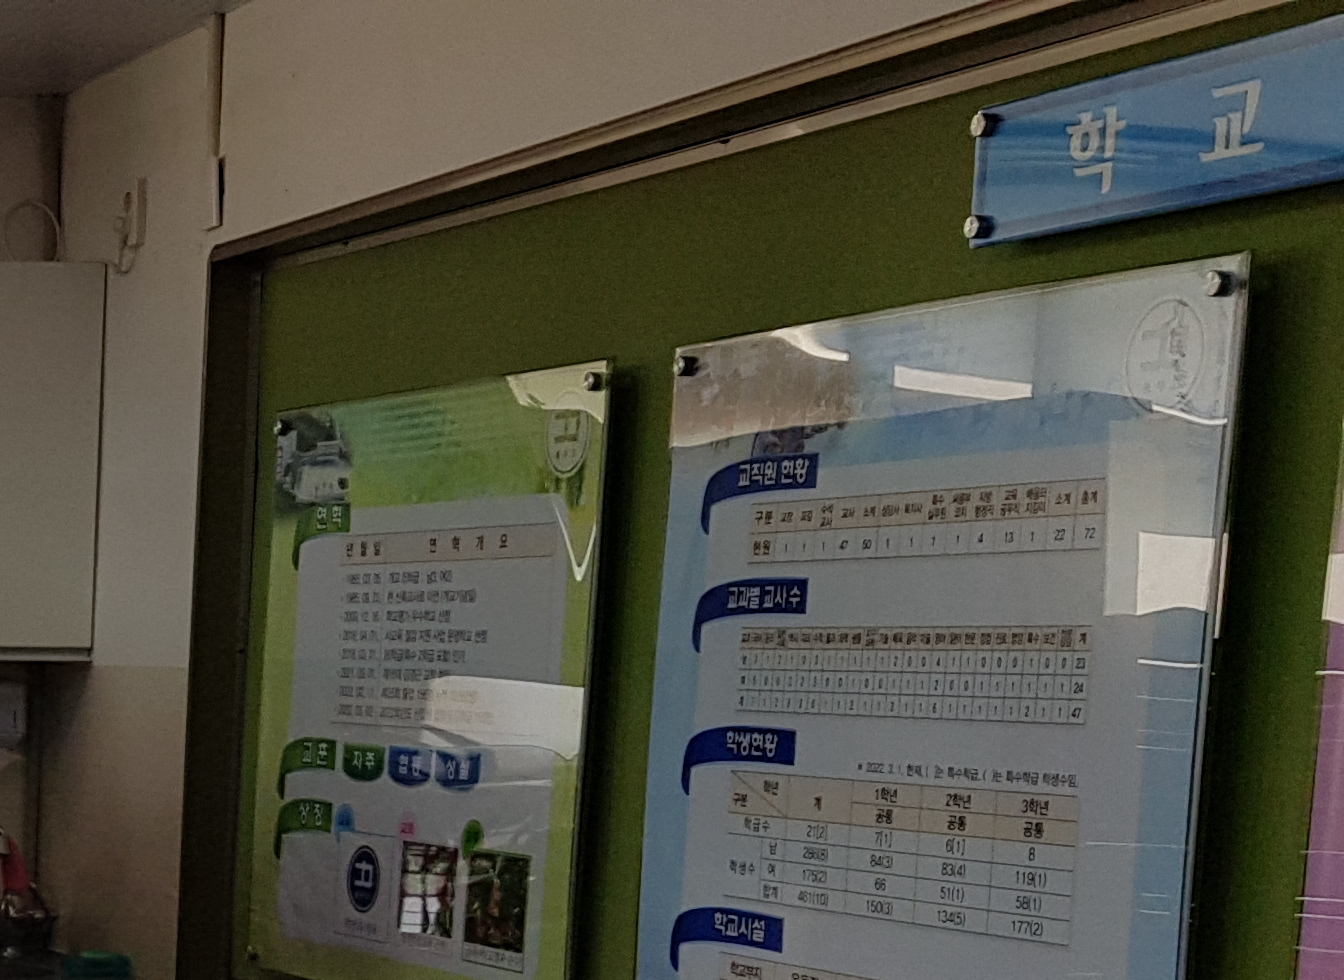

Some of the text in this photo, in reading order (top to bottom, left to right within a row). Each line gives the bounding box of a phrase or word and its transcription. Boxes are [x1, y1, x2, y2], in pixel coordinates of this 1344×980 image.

[1066, 77, 1265, 194] 학 교
[738, 457, 810, 488] 교직원 현황
[1084, 527, 1096, 539] 72
[727, 584, 801, 610] 교과별 교사 수
[726, 730, 779, 758] 학생현황
[1021, 798, 1049, 816] 3학년
[1023, 821, 1045, 839] 공통
[1028, 847, 1036, 861] 8
[941, 862, 966, 877] 83(4)
[1015, 870, 1047, 889] 119(1)
[939, 886, 965, 903] 51(1)
[713, 911, 766, 943] 학교시설
[937, 909, 966, 927] 134(5)
[1011, 919, 1044, 938] 177(2)
